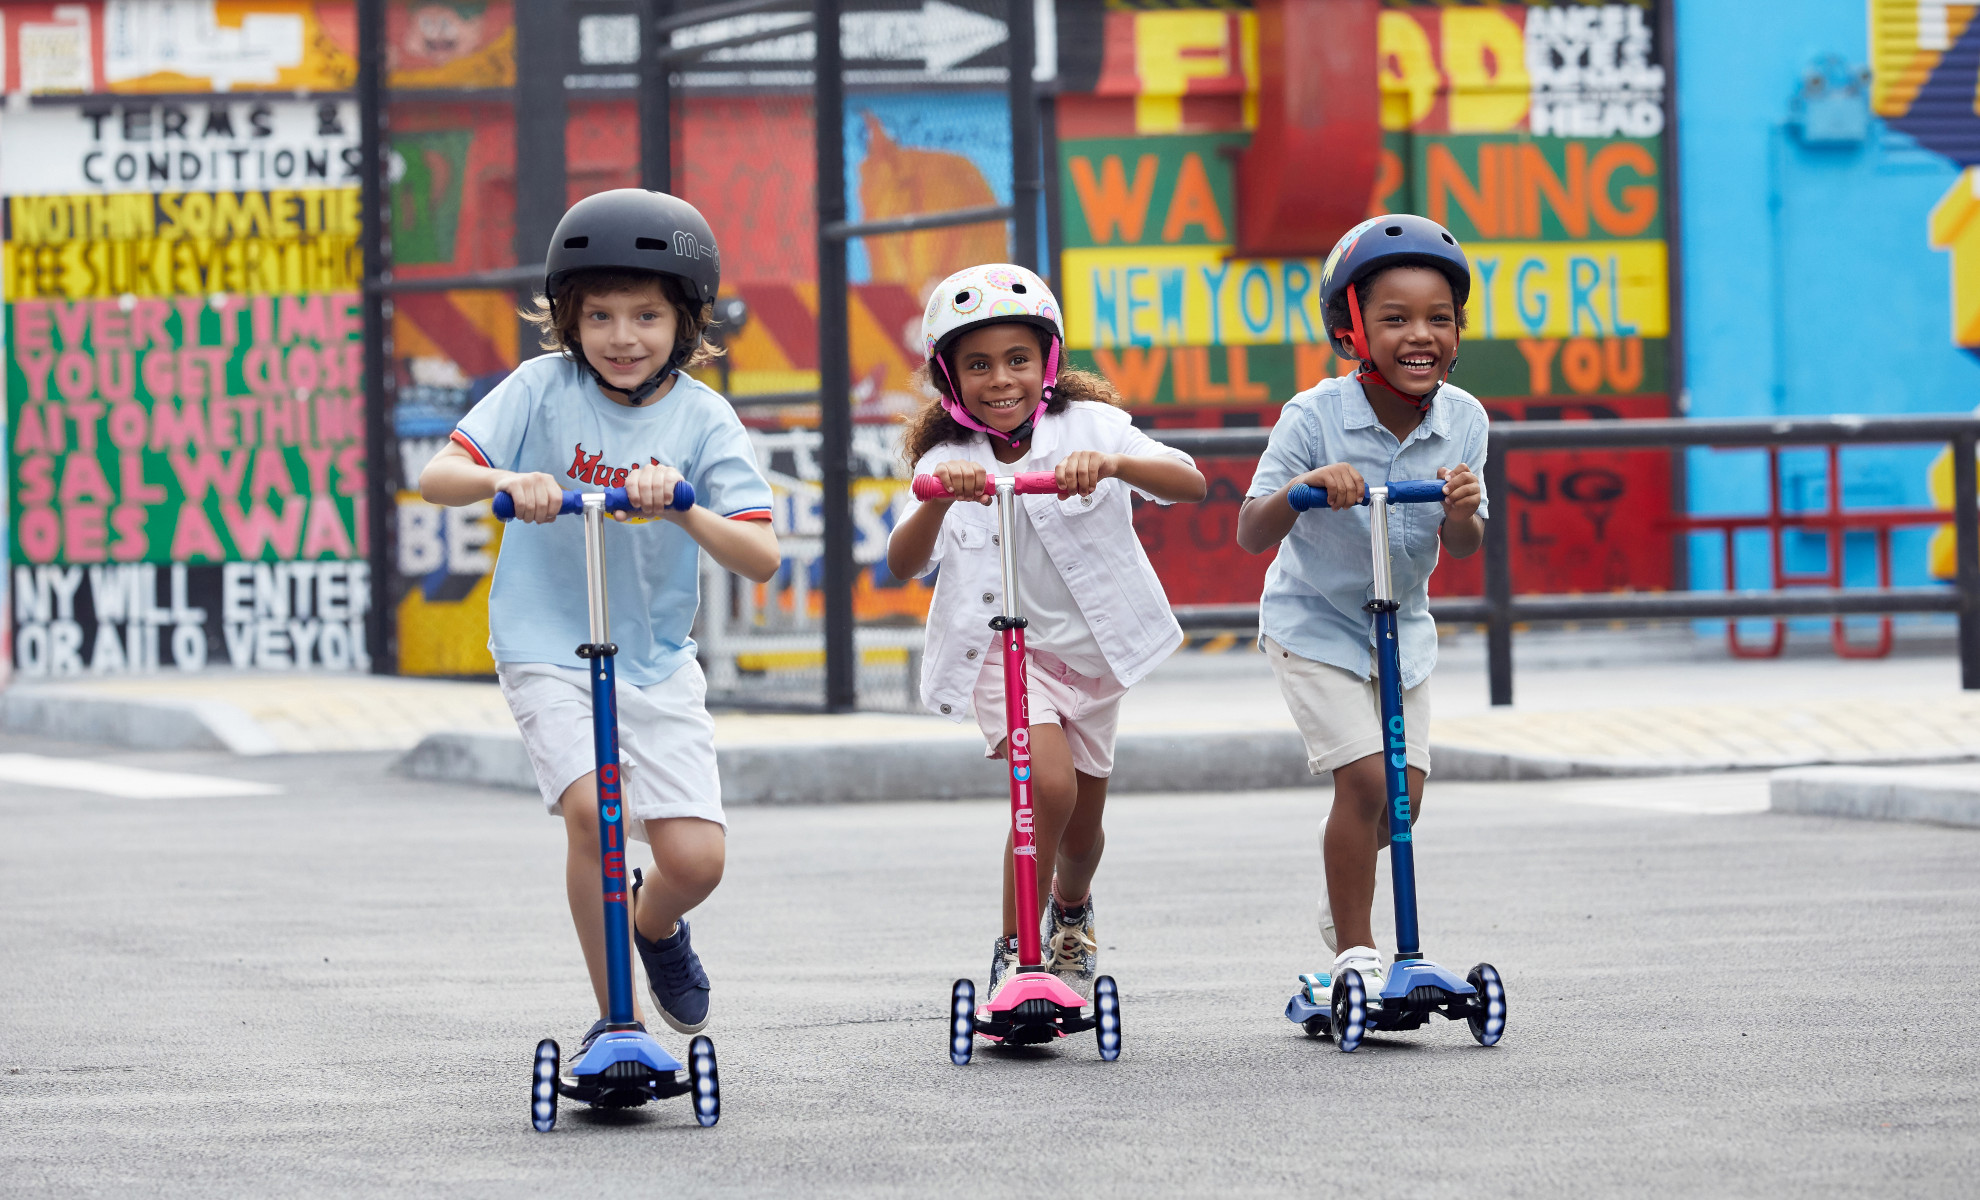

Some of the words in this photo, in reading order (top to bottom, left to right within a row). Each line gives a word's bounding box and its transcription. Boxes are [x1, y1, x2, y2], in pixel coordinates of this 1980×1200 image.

[82, 103, 273, 141] TERMS
[1531, 101, 1665, 137] HEAD
[83, 147, 362, 184] CONDITIONS
[1091, 265, 1186, 348] NEW
[1201, 259, 1318, 344] YOR
[15, 349, 136, 401] YOU
[141, 347, 231, 400] GET
[1092, 343, 1270, 402] WILL
[1515, 337, 1645, 396] YOU
[19, 505, 149, 563] OES
[89, 562, 208, 625] WILL
